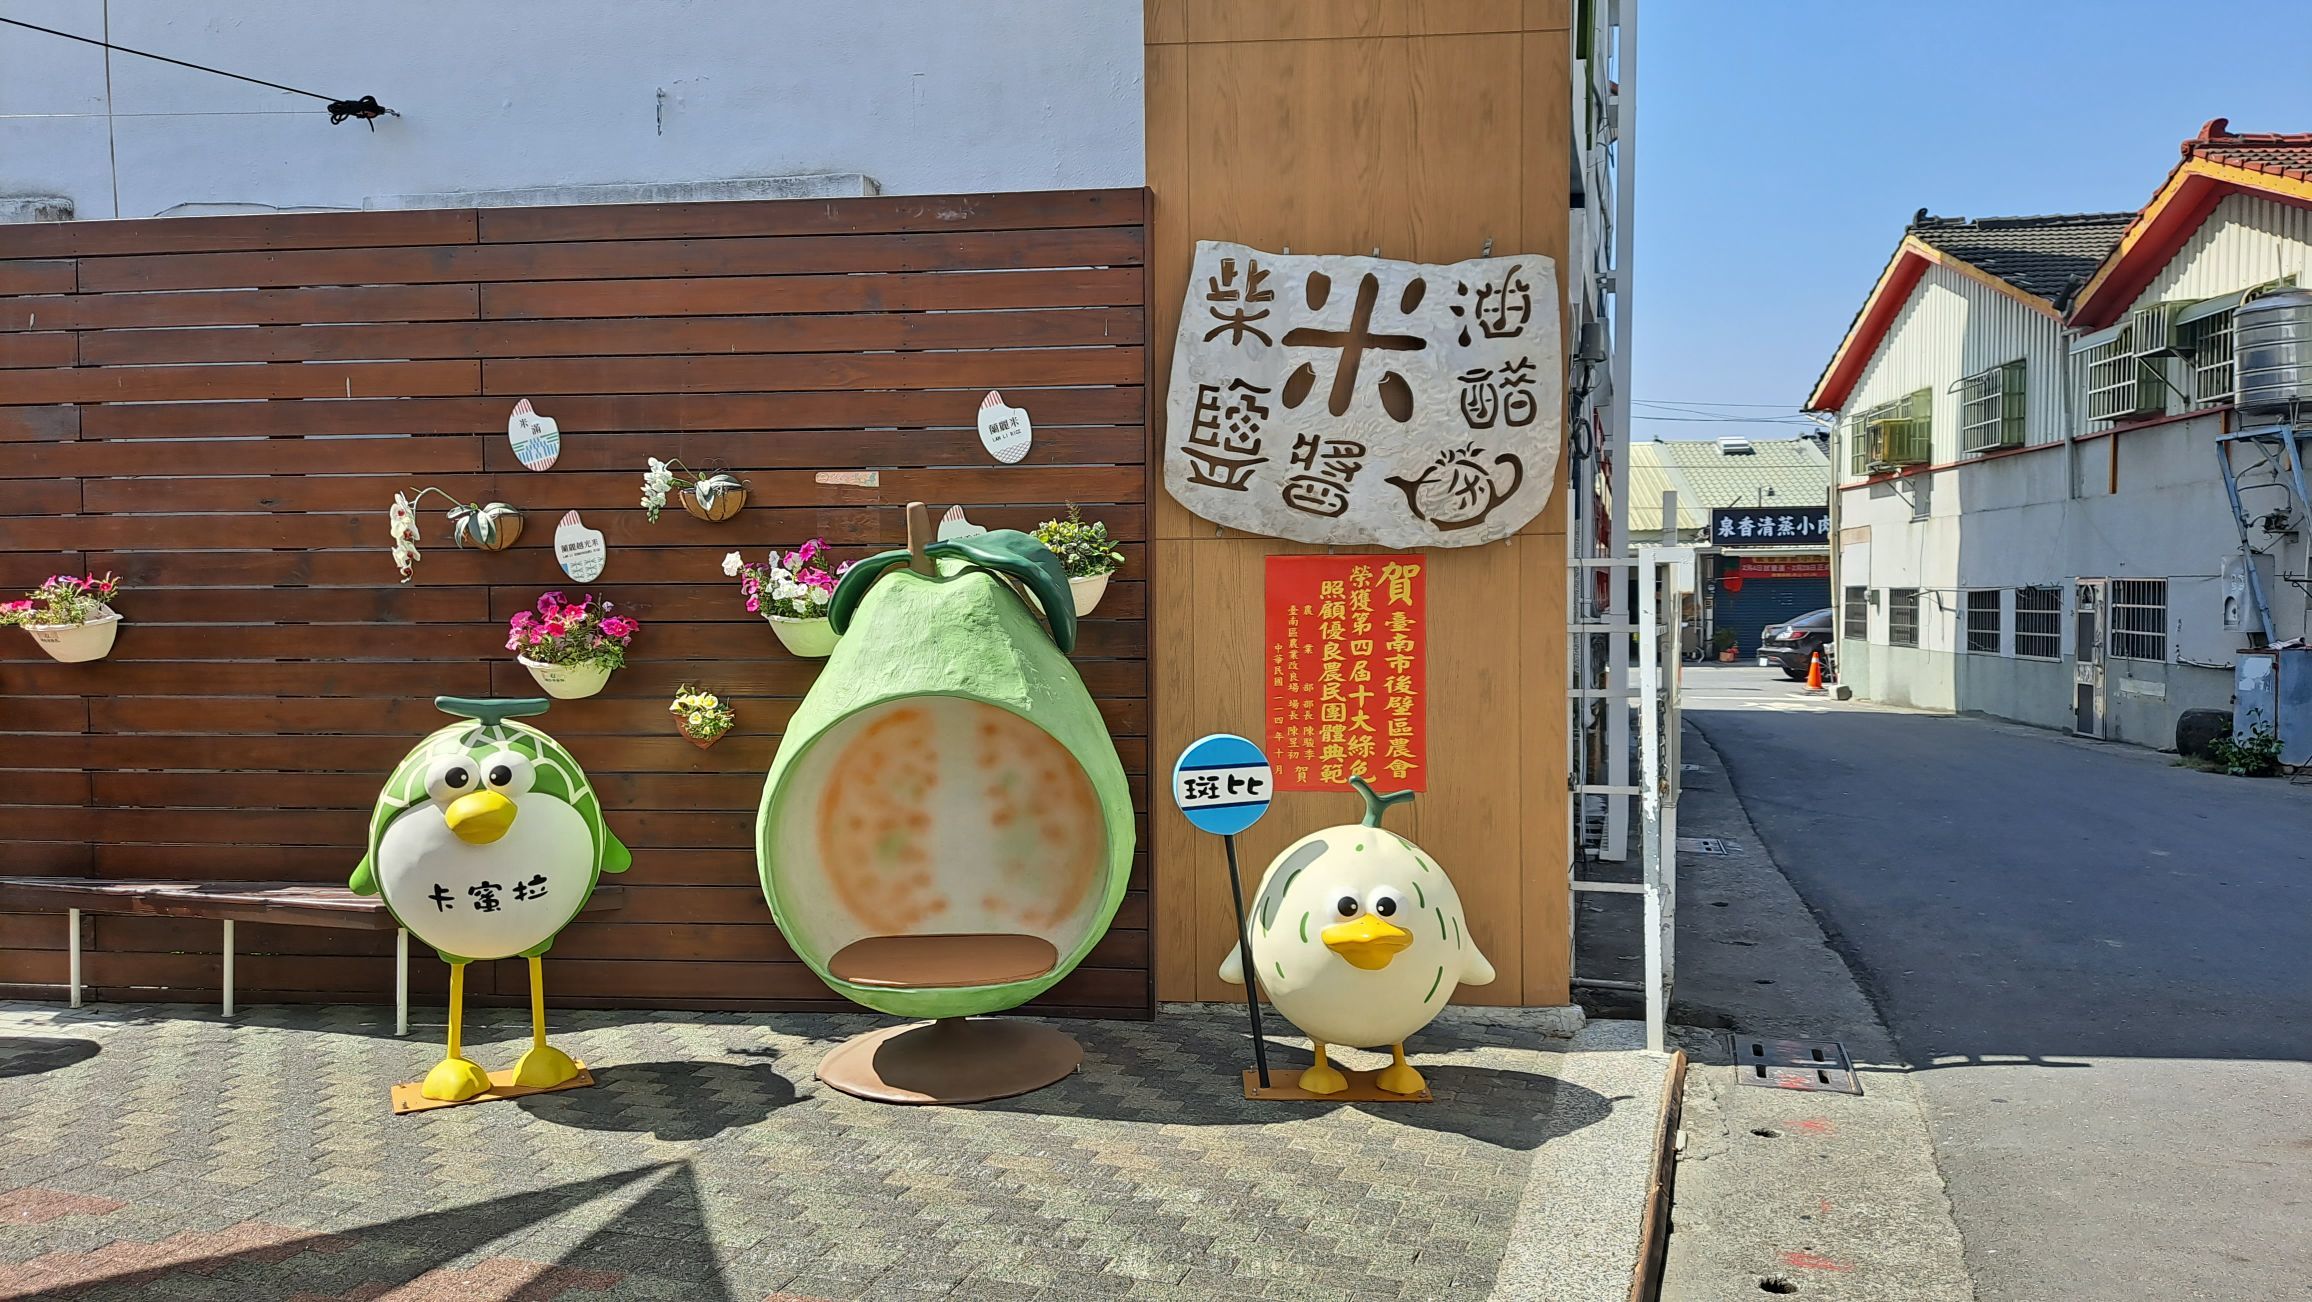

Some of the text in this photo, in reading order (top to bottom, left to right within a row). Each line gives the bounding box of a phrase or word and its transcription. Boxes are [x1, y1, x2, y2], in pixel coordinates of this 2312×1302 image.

[1203, 257, 1532, 424] 柴 米 油
[1281, 432, 1367, 519] 醬
[1457, 355, 1538, 430] 醋
[1317, 580, 1347, 784] 照顧優良農民團體典範
[1348, 564, 1377, 784] 榮獲第四屆十大綠色
[1375, 560, 1421, 779] 賀 臺南市後壁區農會
[1294, 765, 1310, 784] 賀
[428, 874, 549, 913] 卡蜜拉
